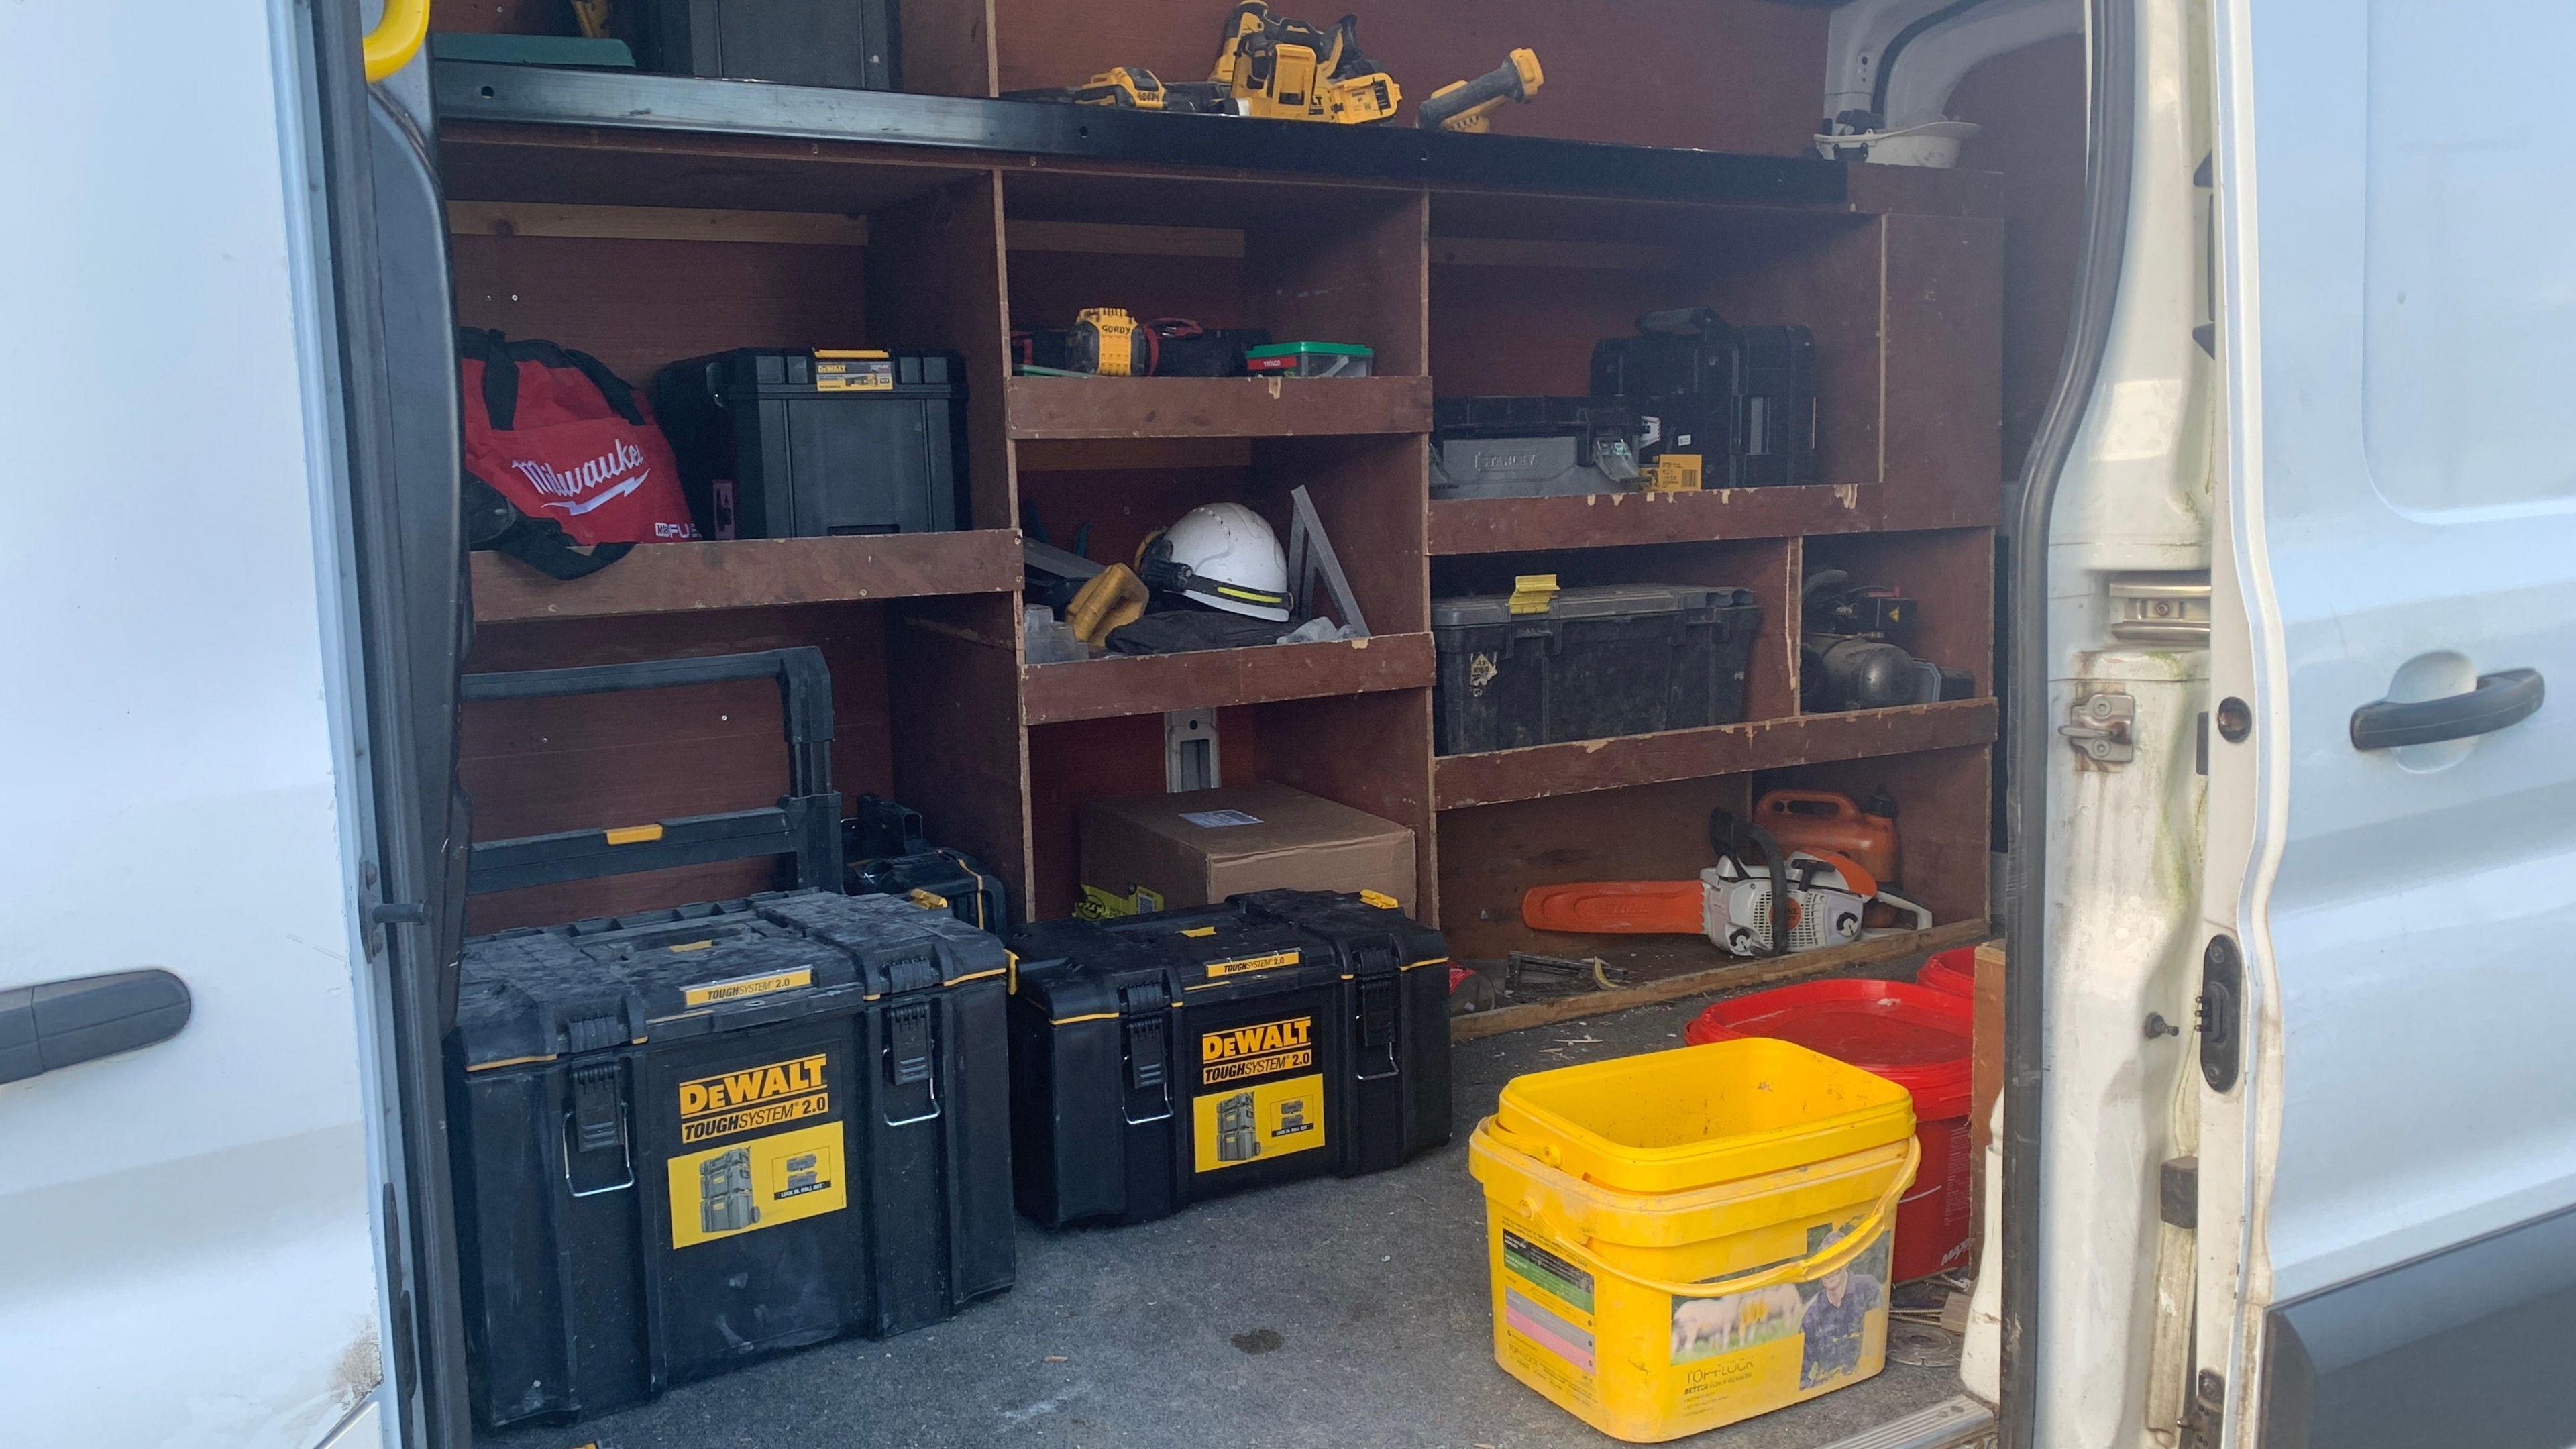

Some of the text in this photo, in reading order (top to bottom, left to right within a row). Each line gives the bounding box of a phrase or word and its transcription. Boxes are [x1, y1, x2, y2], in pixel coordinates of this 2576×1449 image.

[1102, 325, 1130, 335] GORDY
[775, 978, 790, 988] 2.0
[1203, 1020, 1311, 1061] DEWALT
[1292, 1052, 1310, 1067] 2.0
[679, 1057, 827, 1114] DEWALT
[802, 1096, 826, 1114] 2.0
[1684, 1384, 1708, 1395] BETTER
